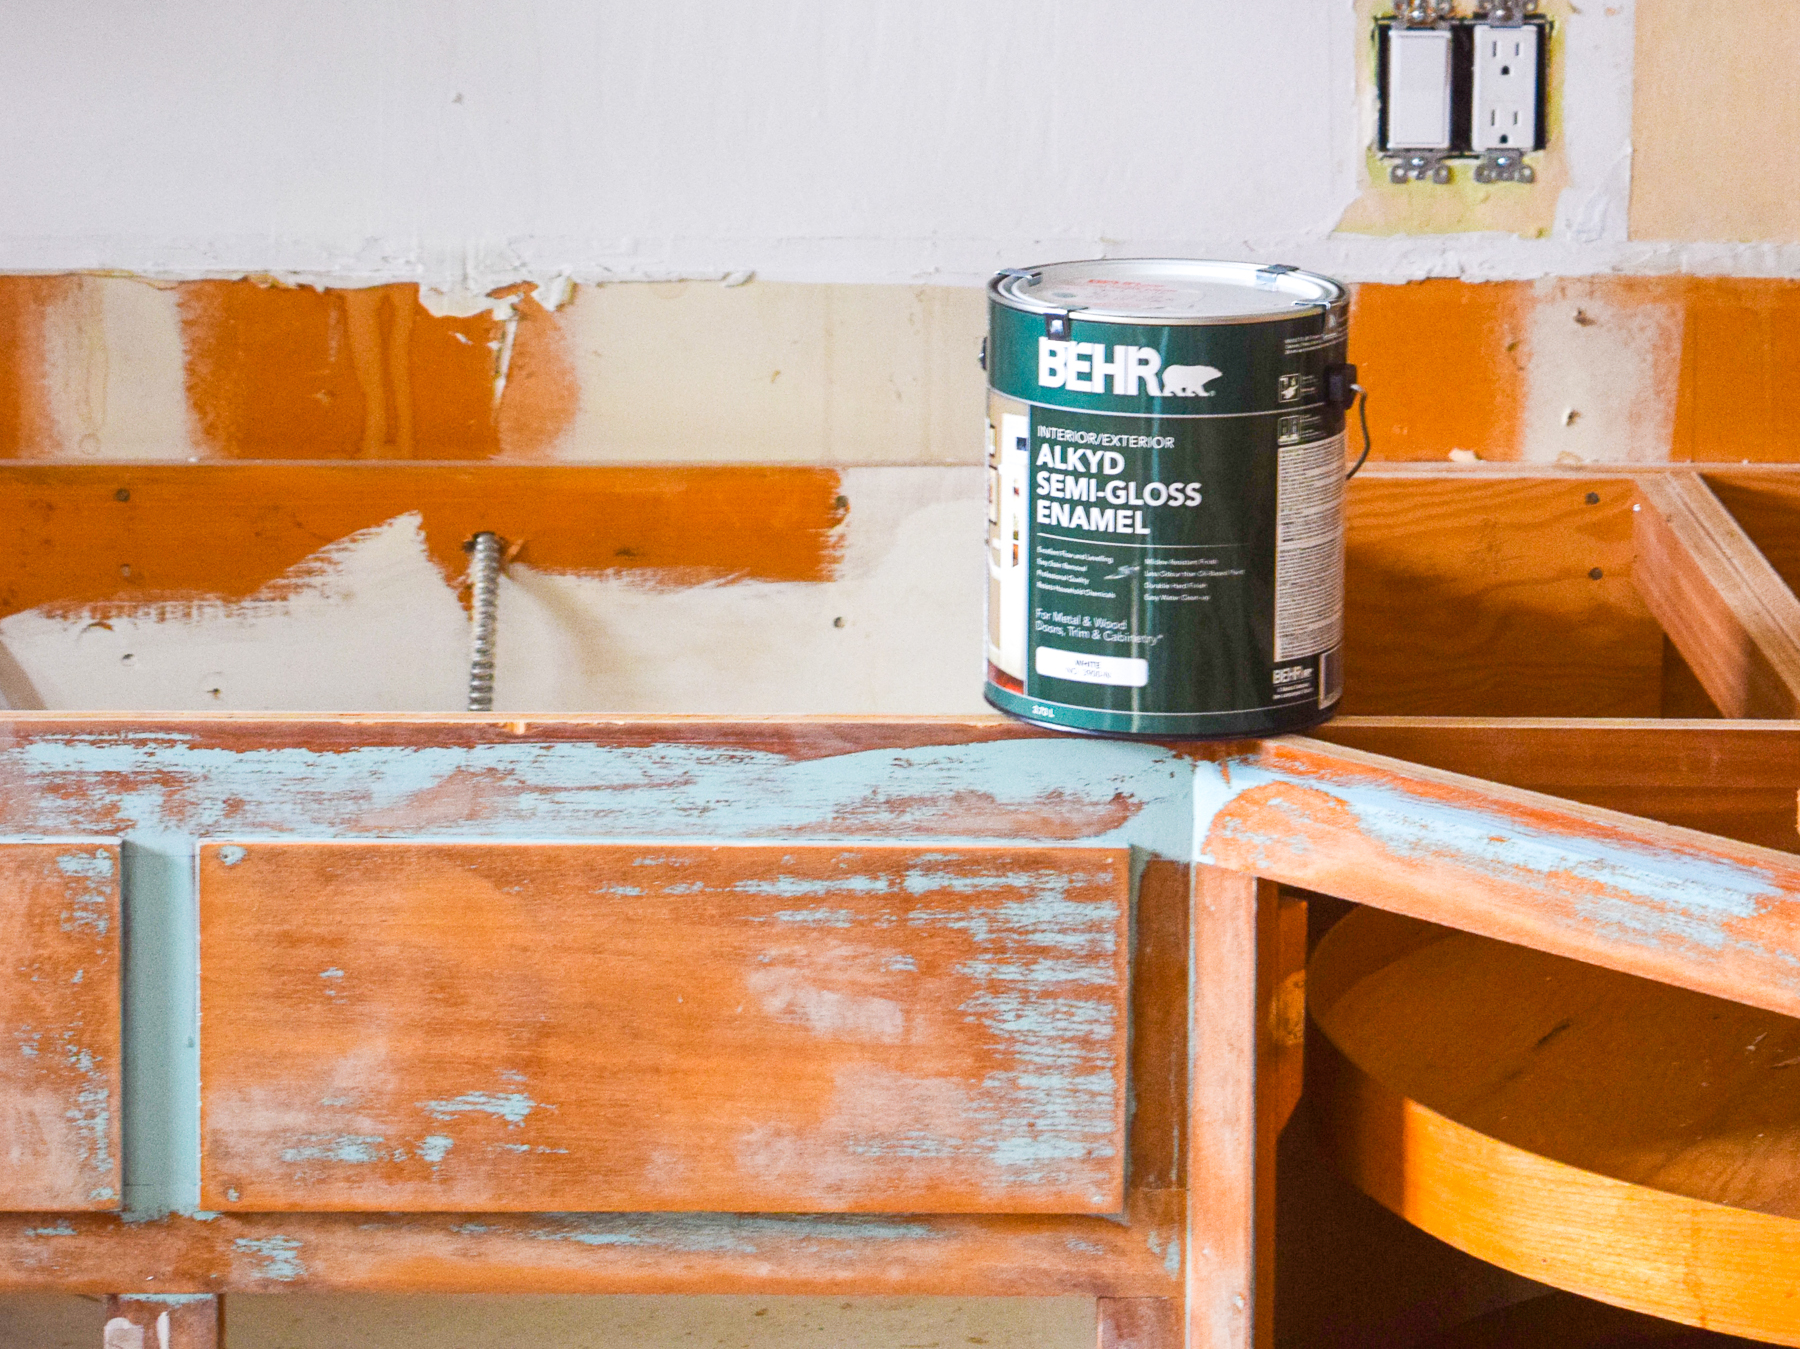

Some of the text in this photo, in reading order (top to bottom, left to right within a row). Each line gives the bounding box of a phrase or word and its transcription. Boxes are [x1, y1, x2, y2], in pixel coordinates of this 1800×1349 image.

[1038, 337, 1162, 397] BEHR
[1037, 425, 1175, 449] INTERIOR/EXTERIOR
[1036, 443, 1126, 475] ALKYD
[1036, 471, 1202, 507] SEMI-GLOSS
[1036, 499, 1151, 535] ENAMEL
[1035, 608, 1128, 630] For Metal & Wood
[1035, 620, 1066, 636] Doors,
[1067, 626, 1090, 639] Trim
[1091, 629, 1101, 640] &
